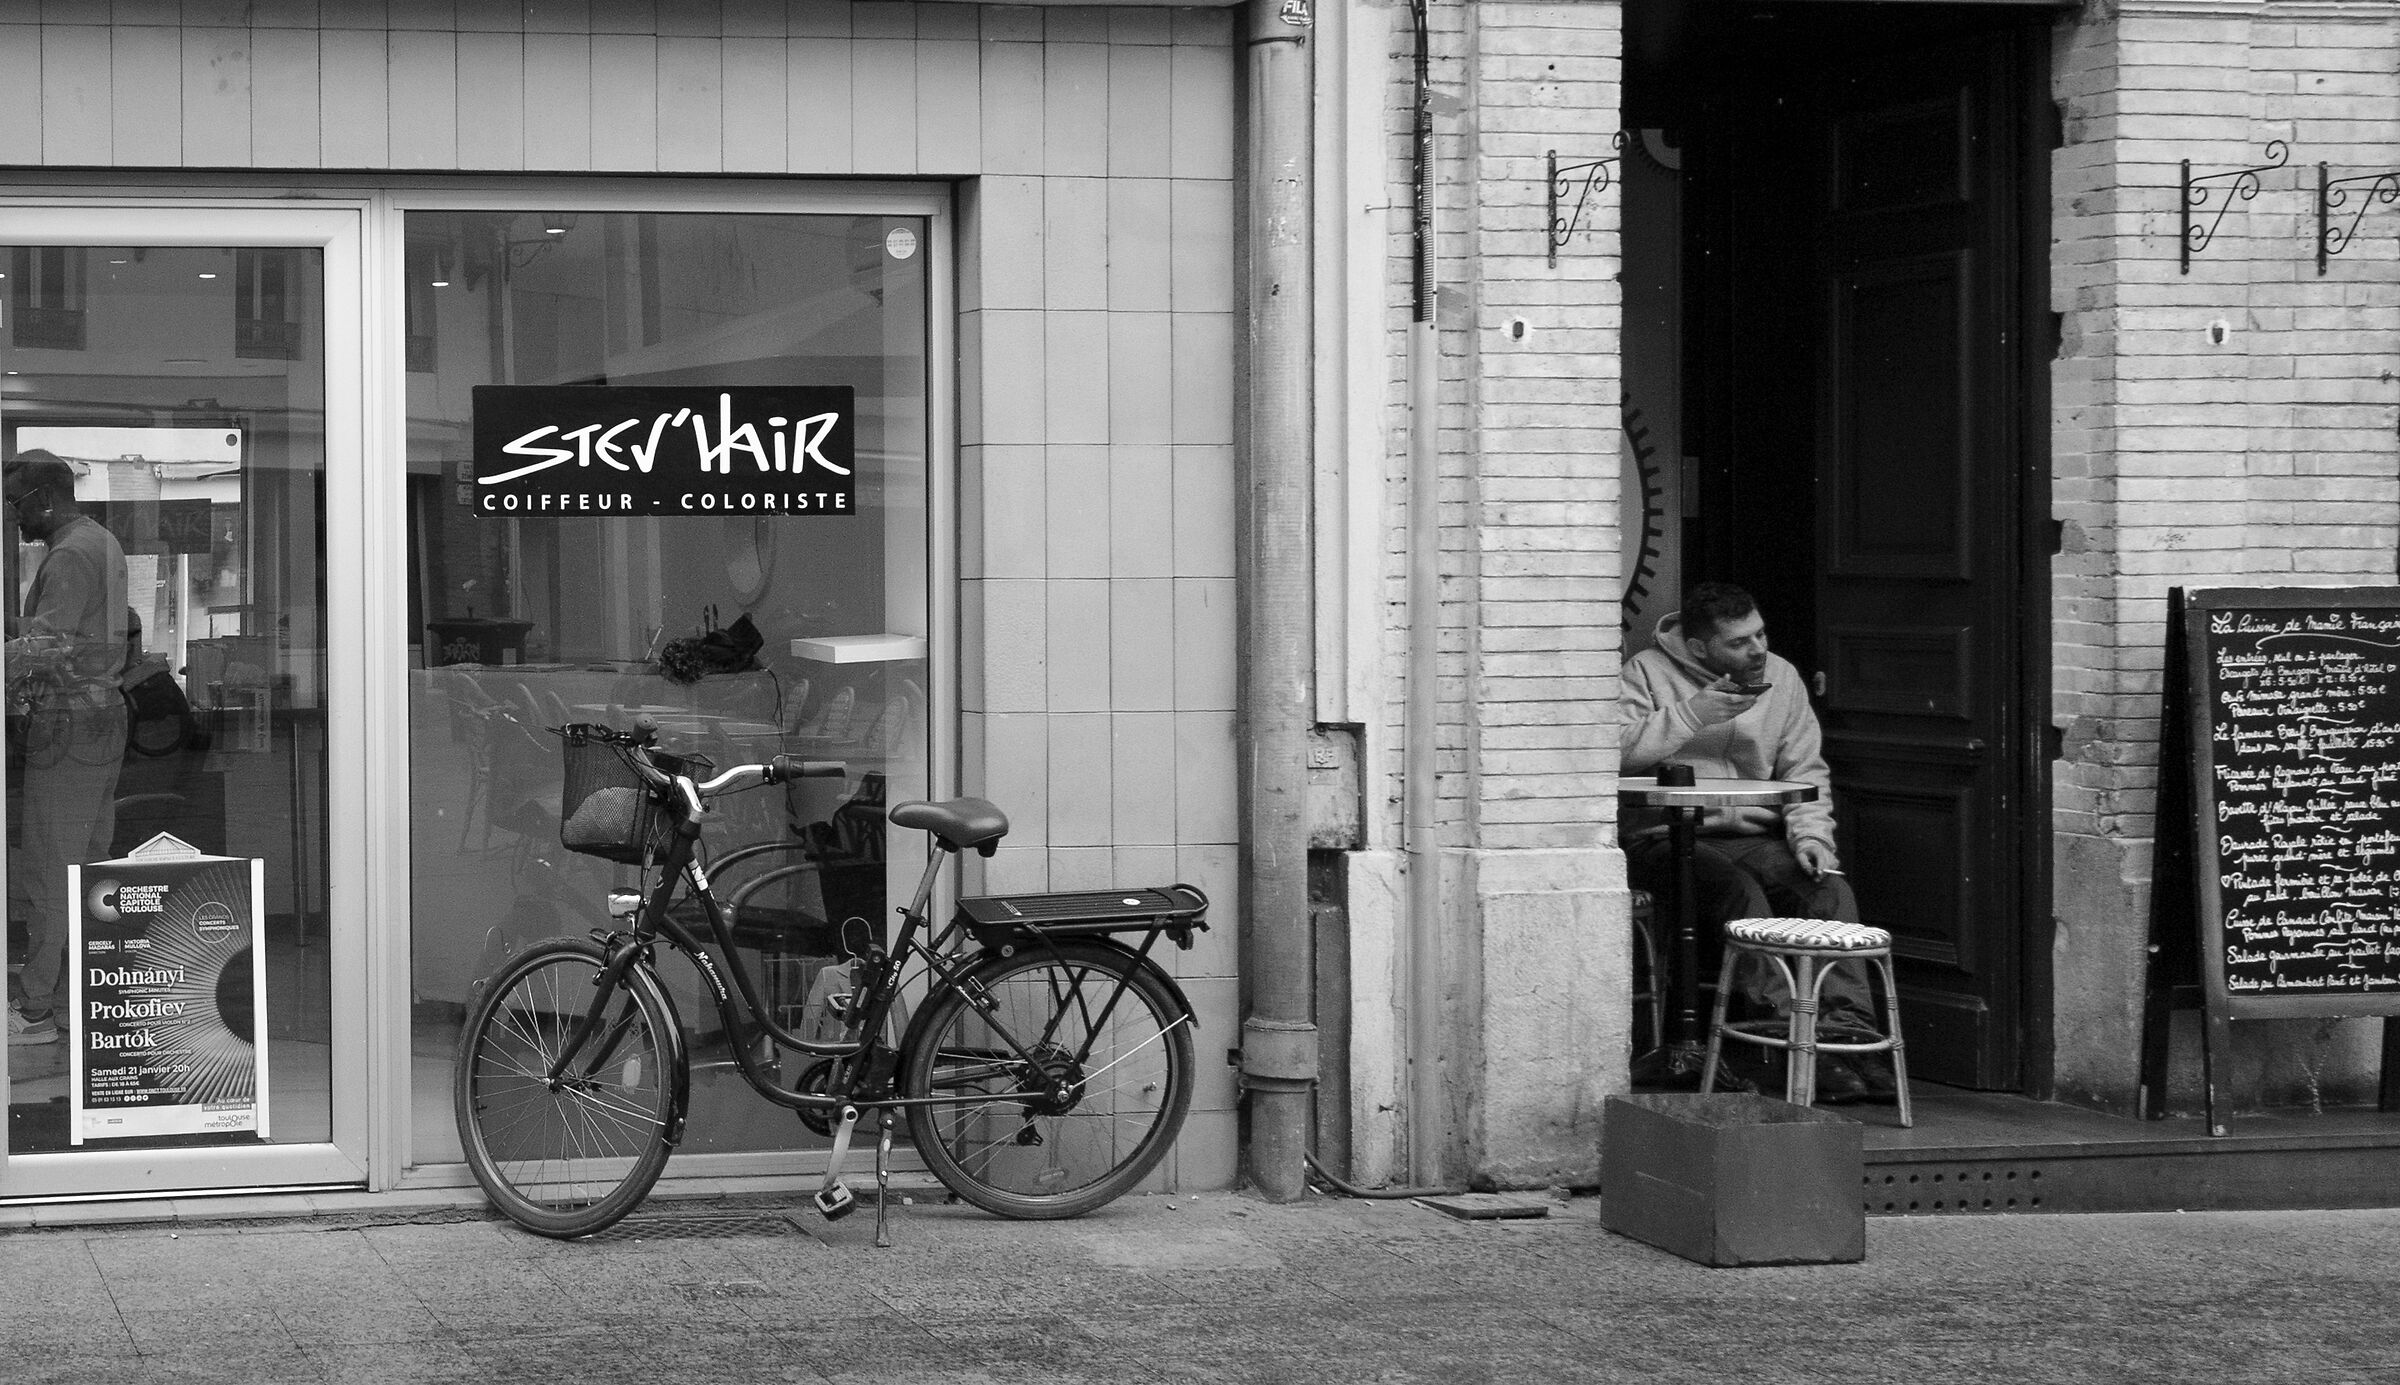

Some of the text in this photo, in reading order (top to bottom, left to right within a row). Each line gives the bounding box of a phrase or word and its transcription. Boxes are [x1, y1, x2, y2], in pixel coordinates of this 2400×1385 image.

[483, 493, 633, 511] COIFFEUR
[680, 492, 847, 510] COLORISTE
[2210, 611, 2235, 634] La
[2279, 618, 2303, 635] de
[2259, 667, 2274, 679] de
[2329, 811, 2343, 821] et
[2337, 848, 2351, 858] et
[2318, 874, 2331, 886] et
[120, 885, 169, 894] ORCHESTRE
[120, 892, 162, 900] NATIONAL
[120, 898, 161, 907] CAPITOLE
[120, 905, 163, 913] TOULOUSE
[2226, 945, 2268, 965] Salade
[89, 965, 185, 988] Dohnányi
[90, 998, 186, 1020] Prokofiev
[90, 1028, 158, 1050] Bartók
[91, 1064, 190, 1077] Samedi 21 janvier 20h
